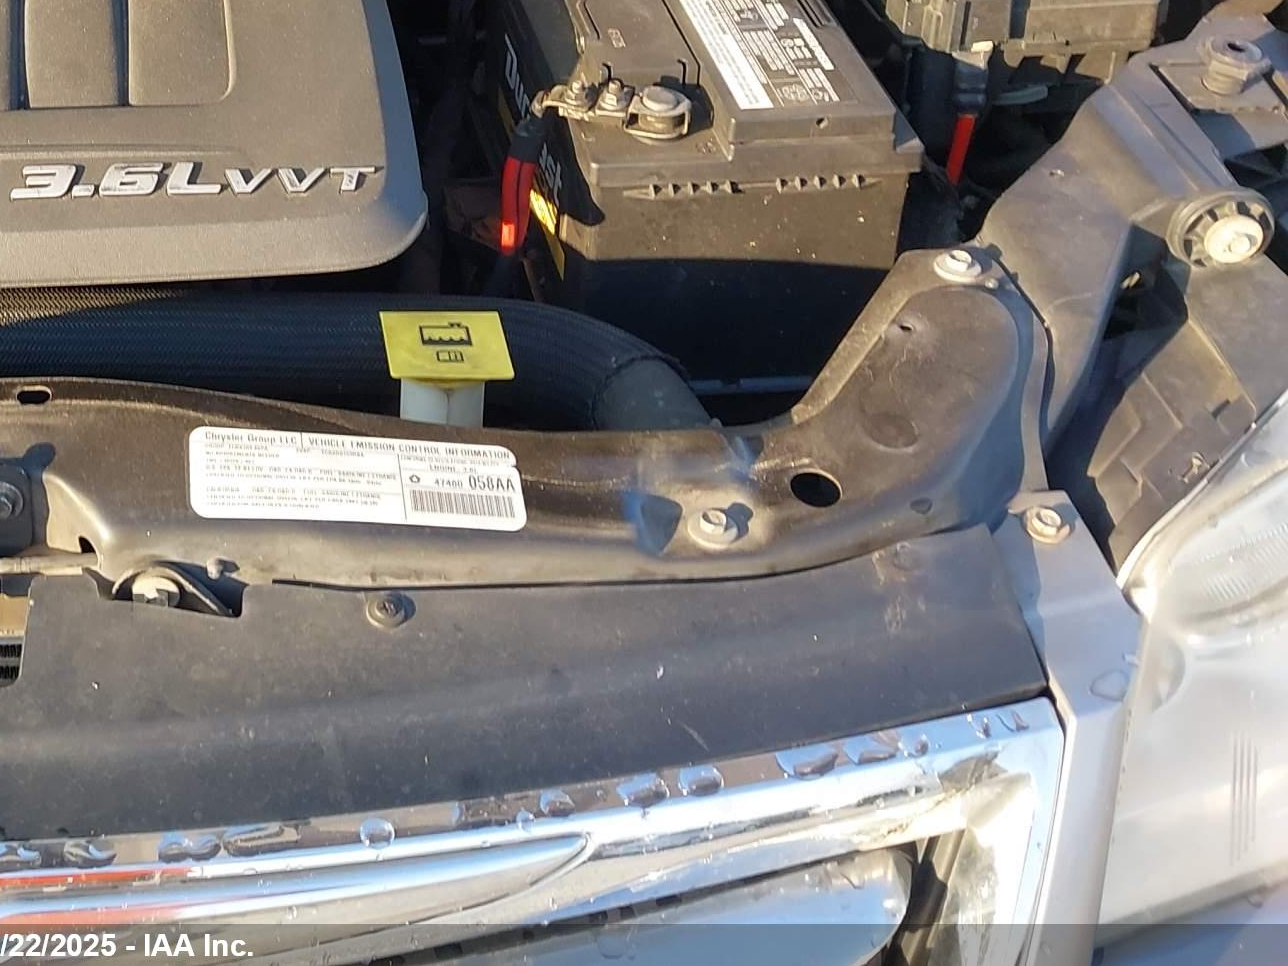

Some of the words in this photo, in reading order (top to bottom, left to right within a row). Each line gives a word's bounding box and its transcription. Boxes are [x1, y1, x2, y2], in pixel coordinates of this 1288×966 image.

[11, 161, 223, 200] 3.6L
[224, 166, 383, 194] VVT
[205, 431, 243, 444] Chrysler
[247, 433, 276, 447] Group
[279, 436, 297, 445] LLC
[309, 436, 345, 448] VEHICLE
[350, 440, 395, 452] EMISSION
[398, 444, 439, 454] CONTROL
[445, 446, 510, 458] INFORMATION
[468, 474, 516, 491] 058AA
